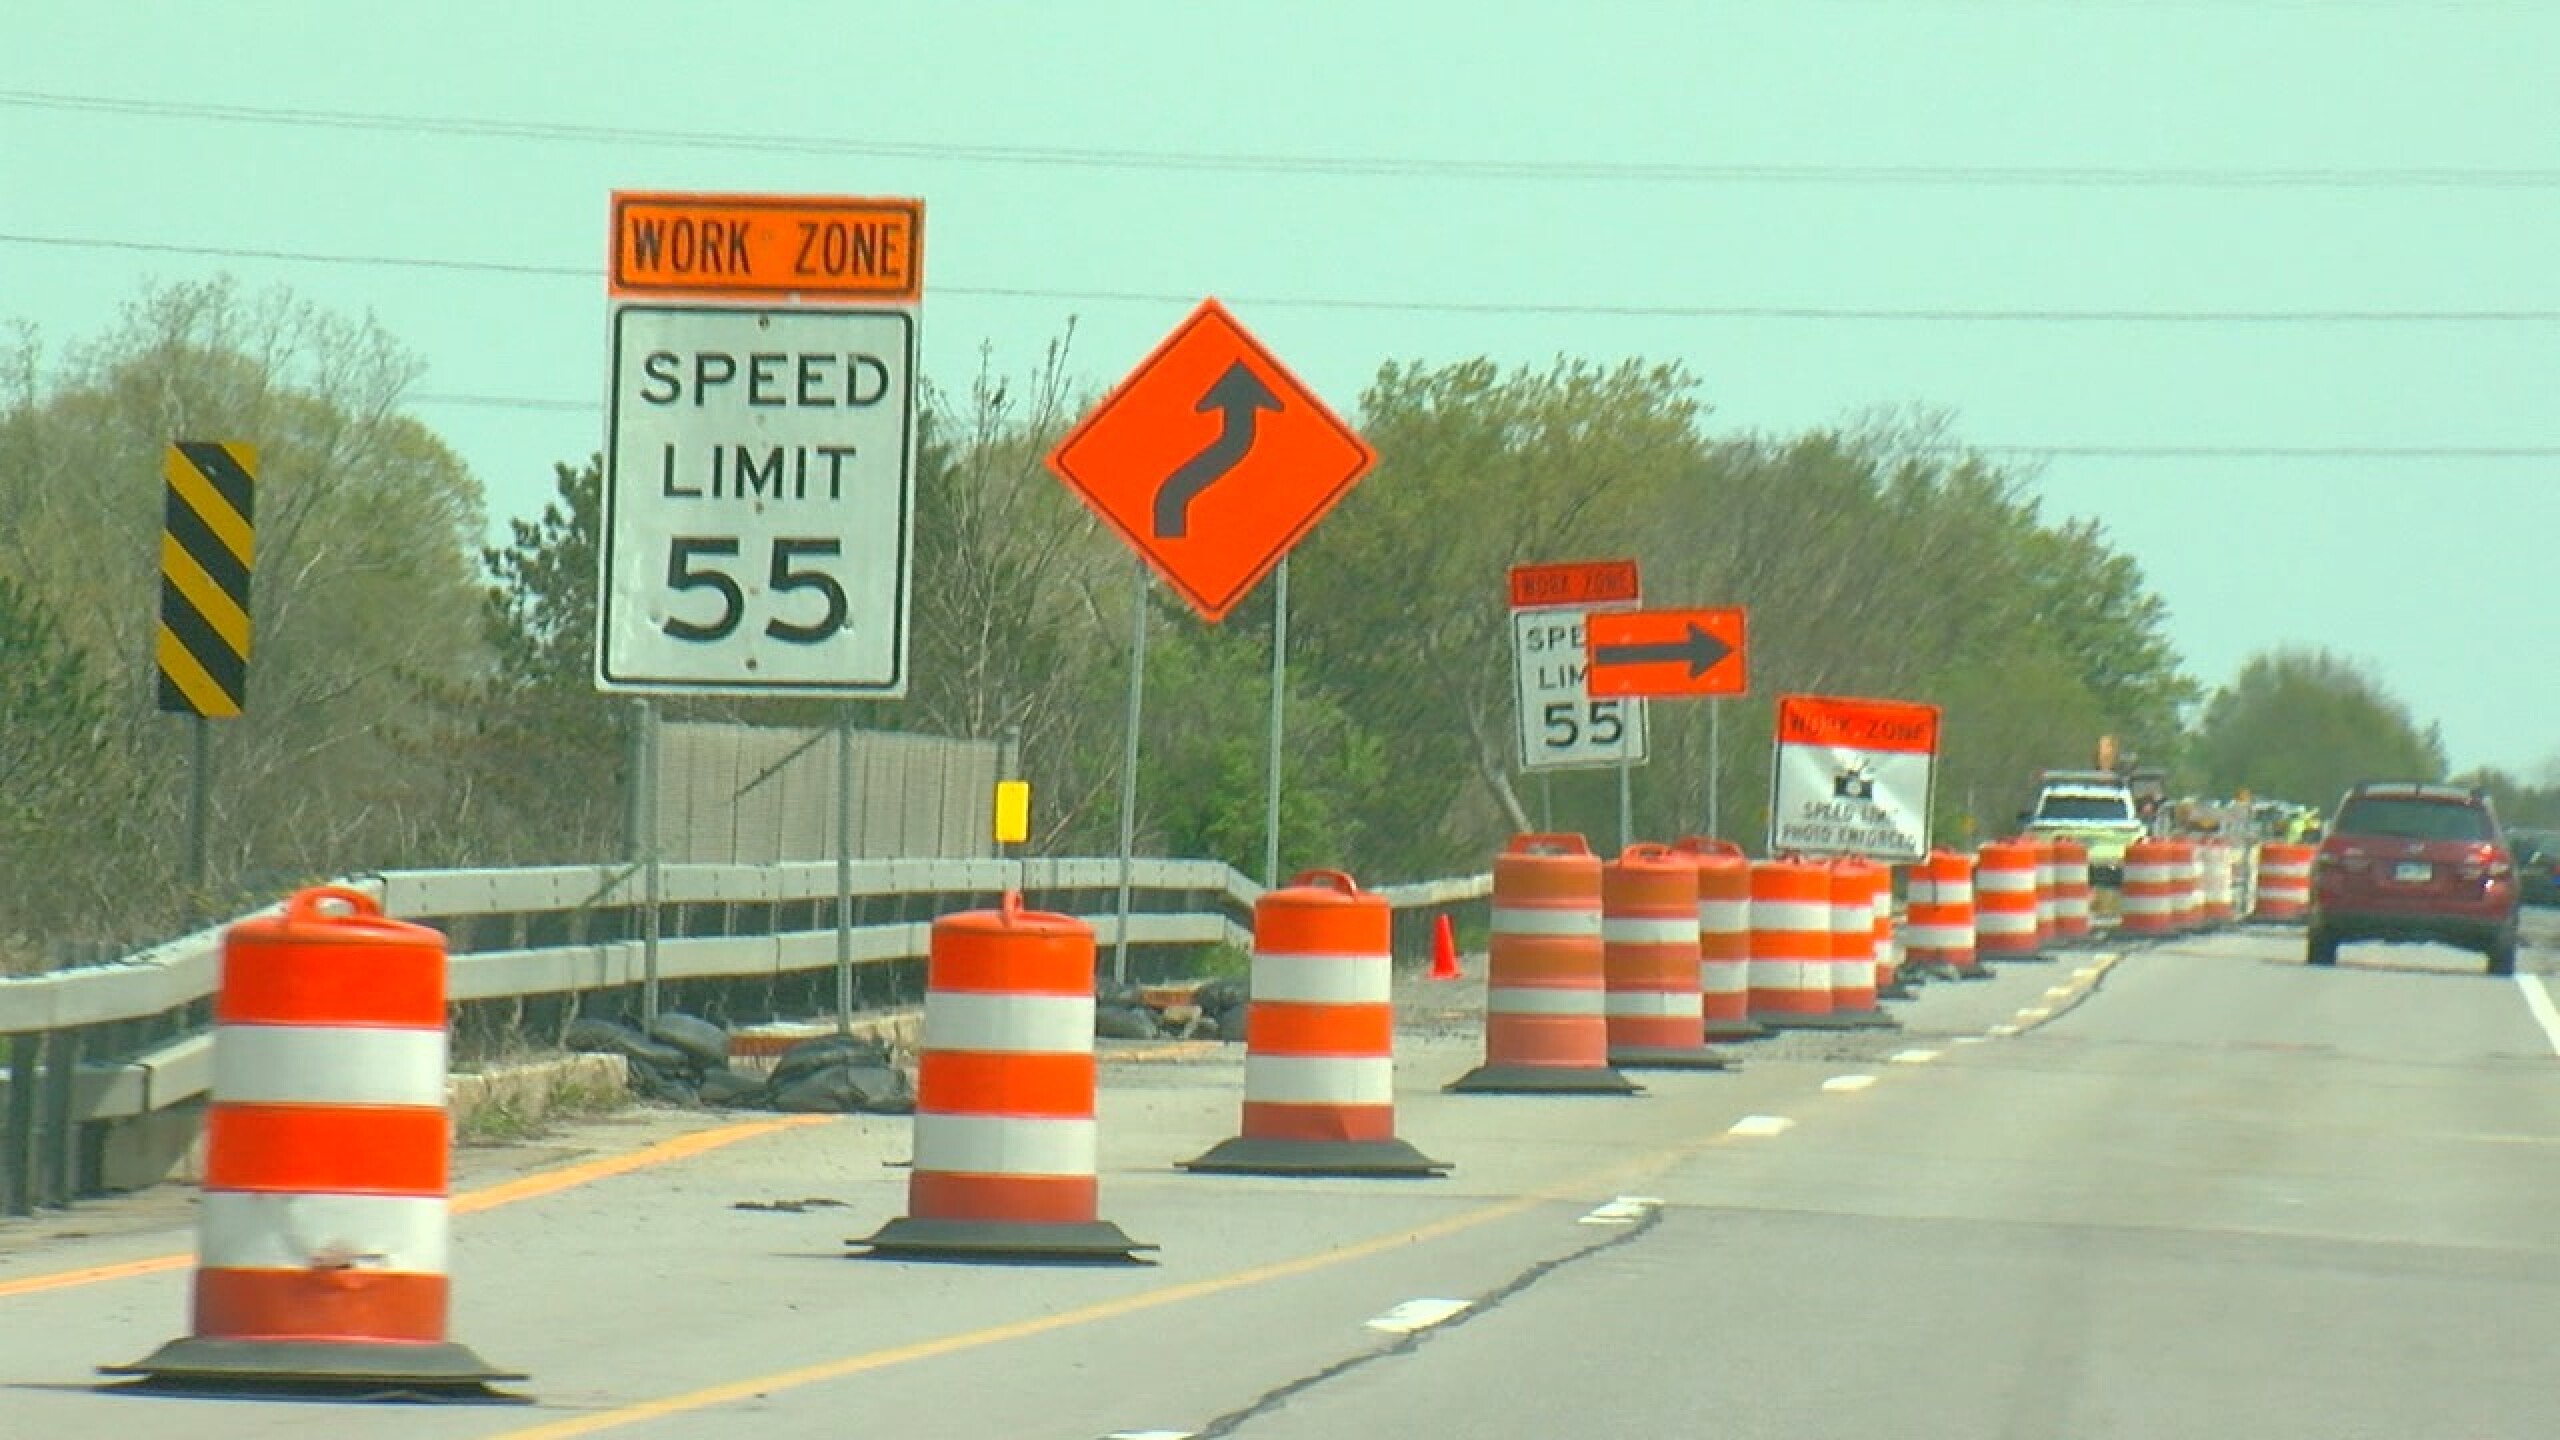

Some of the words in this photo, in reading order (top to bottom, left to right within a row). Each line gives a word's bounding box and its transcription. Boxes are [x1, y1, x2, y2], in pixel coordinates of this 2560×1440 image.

[632, 217, 752, 275] WORK
[793, 221, 901, 278] ZONE
[641, 351, 889, 407] SPEED
[663, 444, 856, 500] LIMIT
[662, 537, 848, 645] 55
[1523, 572, 1569, 598] WORK
[1527, 625, 1586, 652] SPE
[1538, 664, 1588, 690] LIM
[1545, 701, 1623, 747] 55
[1866, 719, 1925, 741] ZONE
[1803, 801, 1853, 822] SPEED
[1861, 804, 1899, 826] LIM
[1783, 823, 1833, 843] PHOTO
[1838, 826, 1917, 851] ENFORCED
